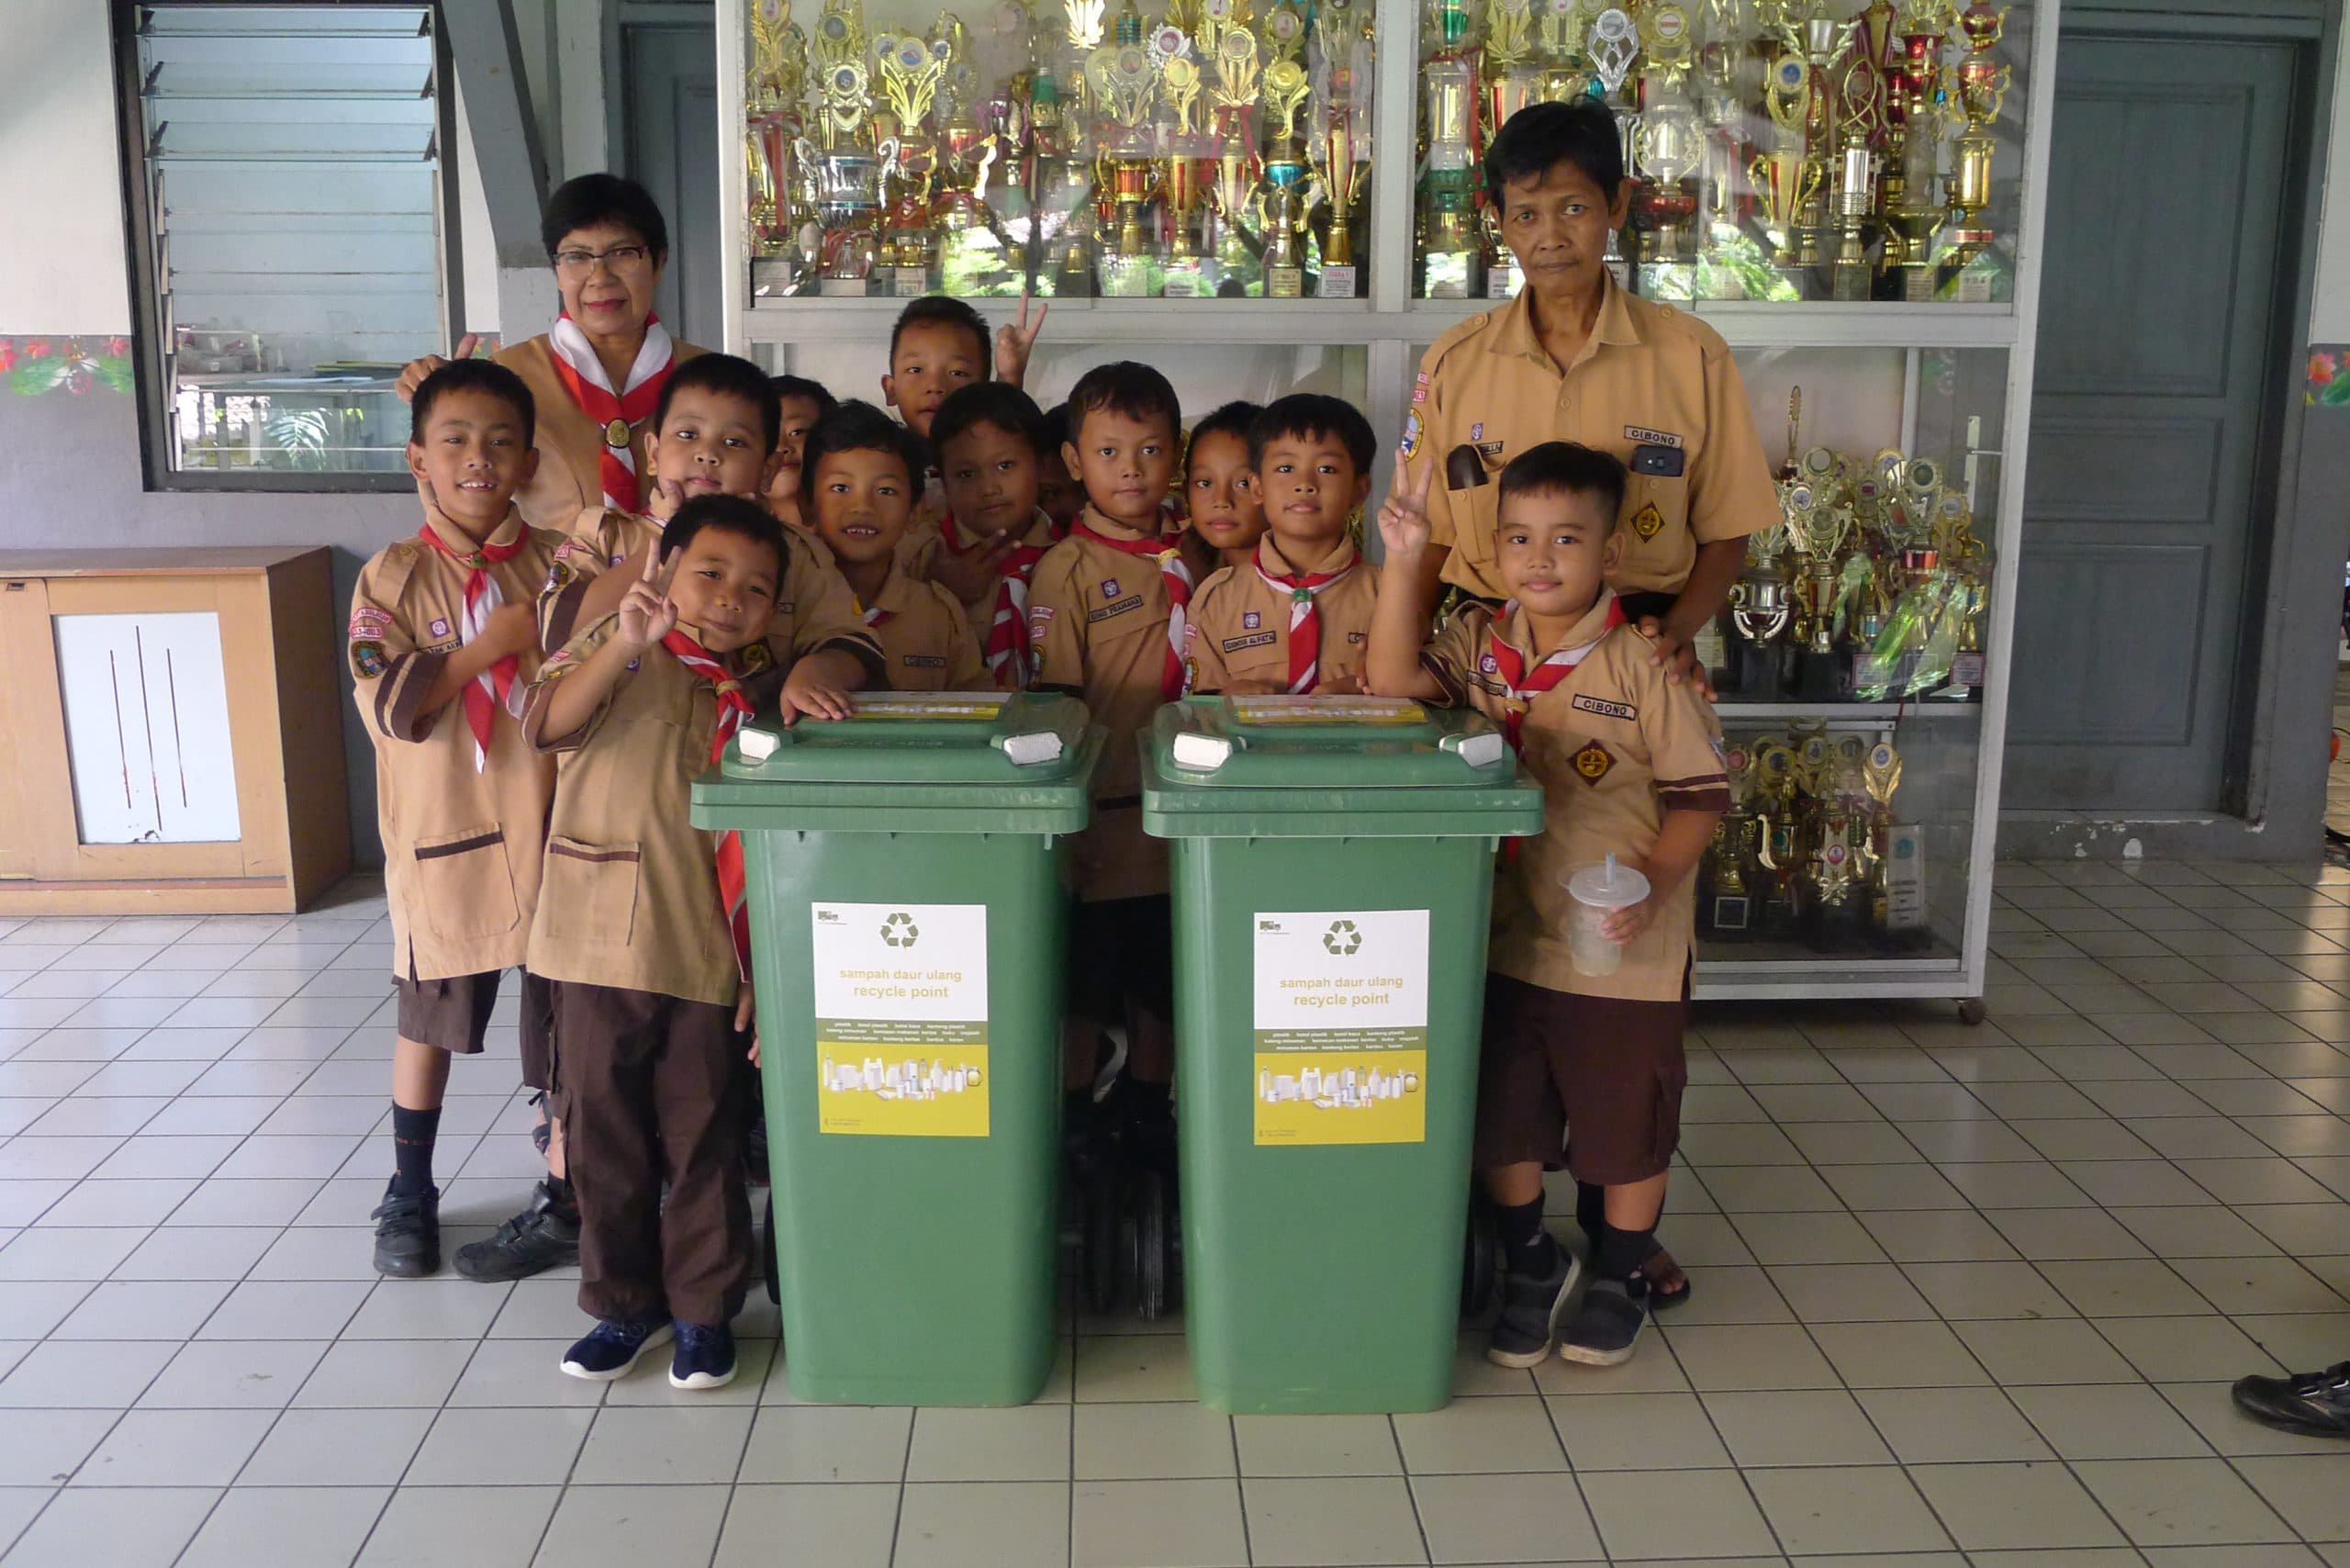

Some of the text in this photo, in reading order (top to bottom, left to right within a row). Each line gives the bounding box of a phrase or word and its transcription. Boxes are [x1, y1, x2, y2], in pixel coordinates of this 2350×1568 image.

[1631, 430, 1675, 445] CIBONO
[1583, 700, 1628, 716] CIBONO
[839, 969, 962, 982] sampah daur ulang
[1279, 976, 1404, 991] sampah daur ulang
[854, 985, 949, 1000] recycle point
[1293, 992, 1390, 1008] recycle point
